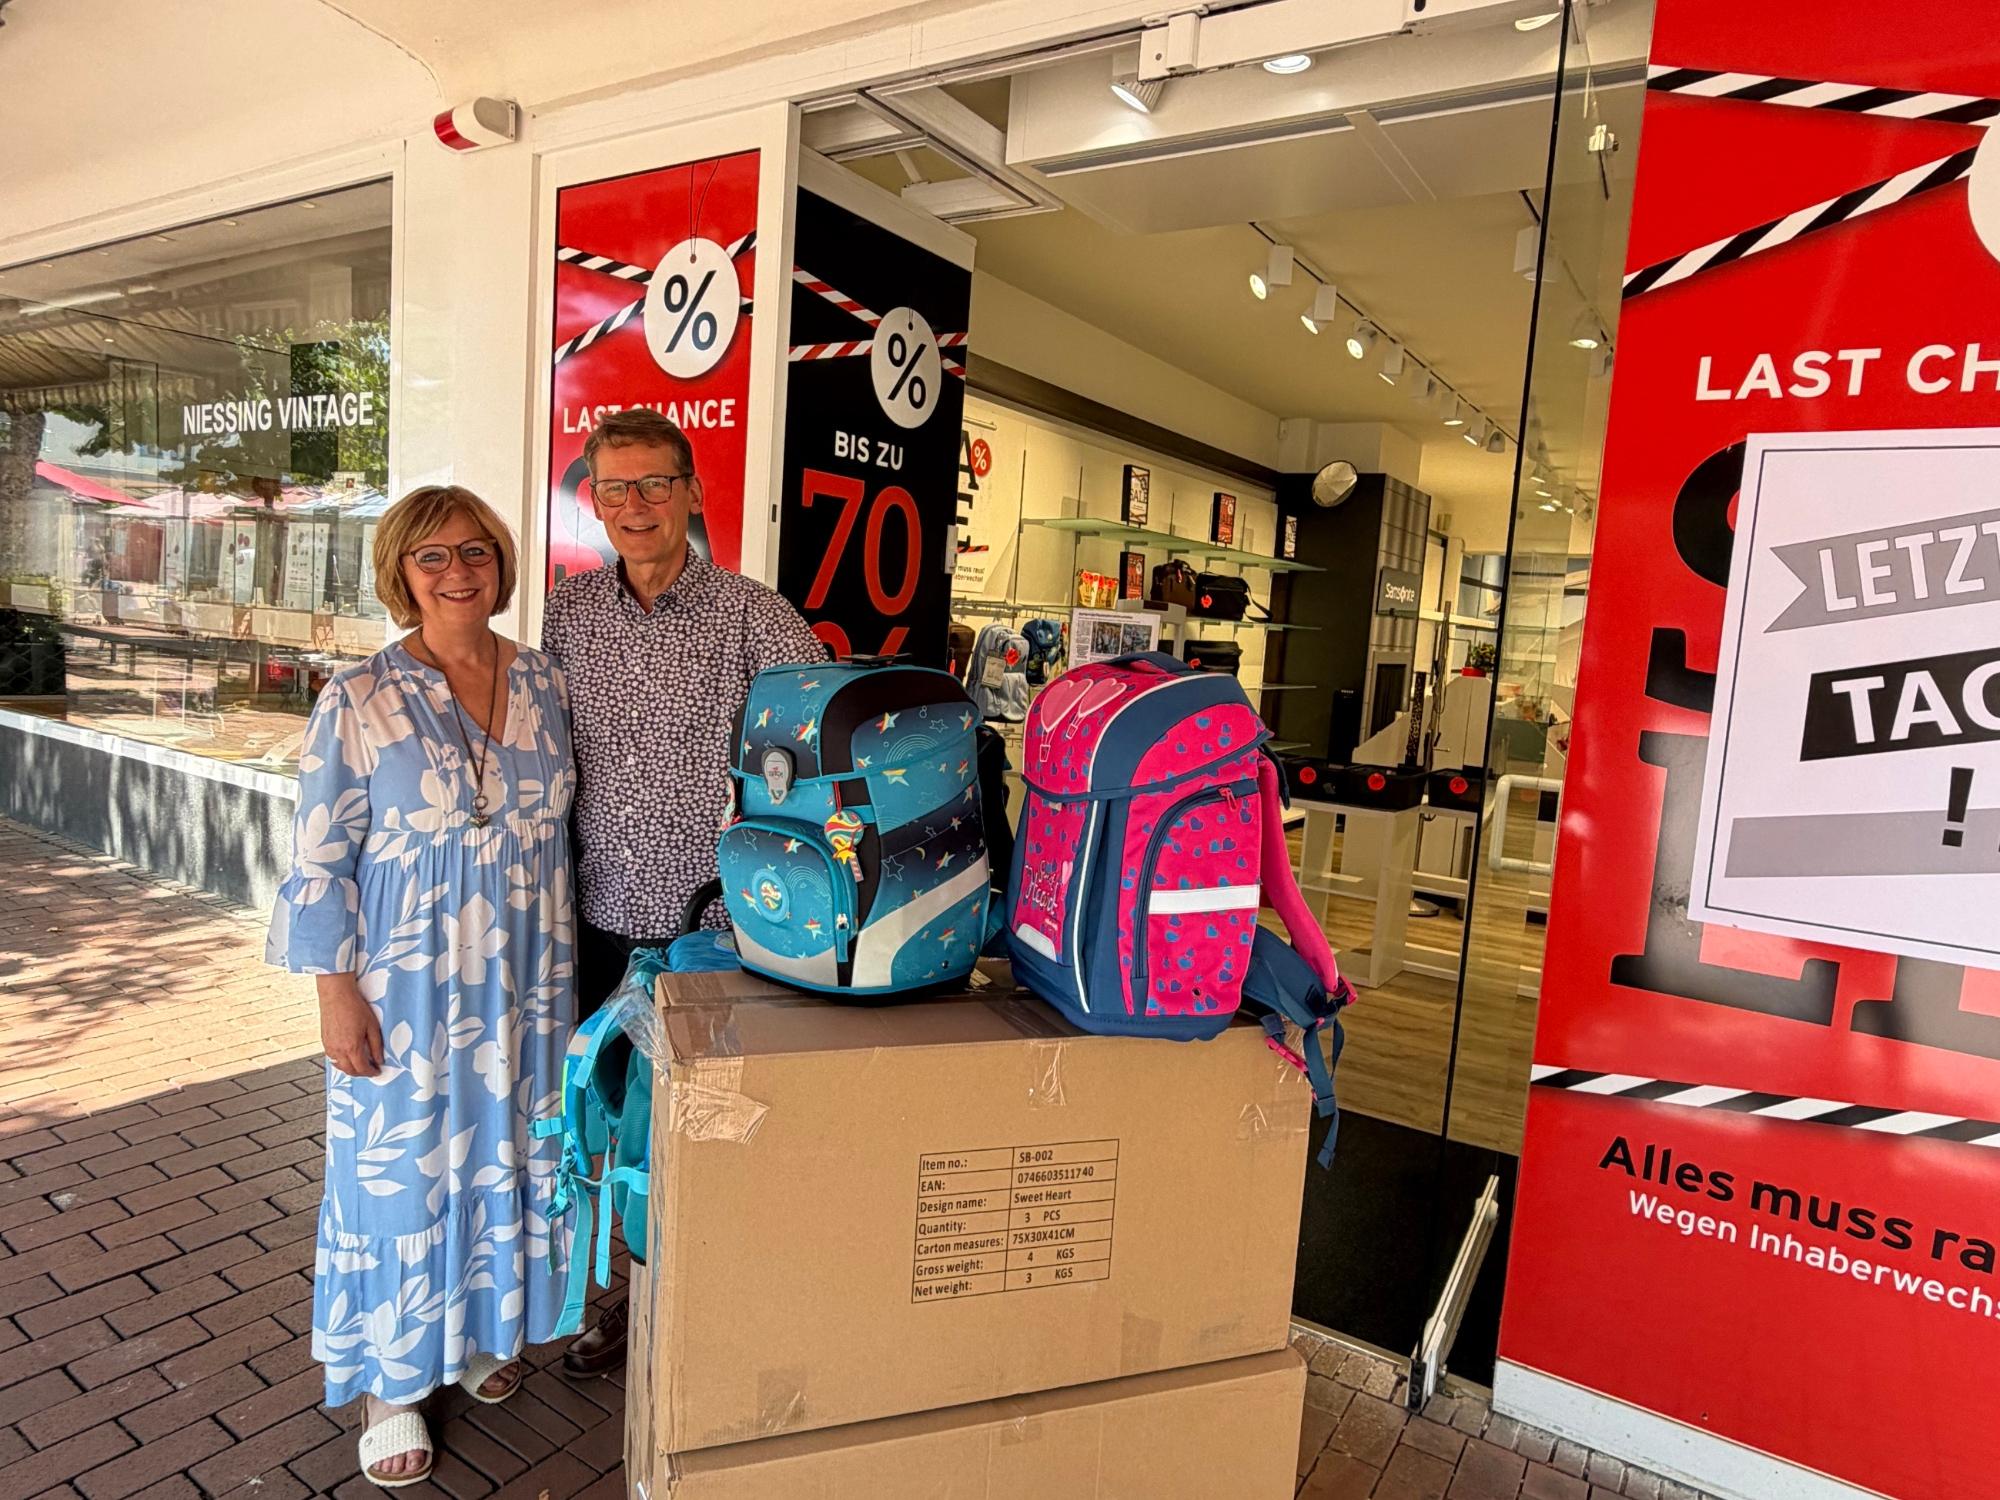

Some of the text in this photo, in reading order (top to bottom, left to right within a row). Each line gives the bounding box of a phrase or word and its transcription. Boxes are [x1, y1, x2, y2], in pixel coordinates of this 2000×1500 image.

[663, 270, 718, 353] %
[887, 333, 926, 410] %
[1695, 348, 1881, 401] LAST
[183, 391, 374, 435] NIESSING VINTAGE
[629, 399, 736, 429] ANCE
[834, 431, 904, 470] BIS ZU
[974, 445, 987, 470] %
[802, 468, 922, 616] 70
[922, 1159, 967, 1170] Item no.:
[1019, 1150, 1053, 1163] SB-002
[1018, 1166, 1094, 1183] 0746603511740
[921, 1180, 945, 1192] EAN:
[920, 1198, 987, 1213] Design name:
[1014, 1190, 1071, 1204] Sweet Heart
[1598, 1136, 1996, 1275] Alles muss ra
[1024, 1210, 1061, 1223] 3 PCS
[1628, 1190, 1738, 1245] Wegen
[919, 1220, 966, 1236] Quantity:
[1012, 1228, 1074, 1245] 75X30X41CM
[917, 1237, 1004, 1255] Carton measures:
[1027, 1248, 1074, 1262] 4 KGS
[916, 1259, 983, 1276] Gross weight:
[1026, 1267, 1073, 1283] 3 KGS
[914, 1280, 972, 1297] Net weight:
